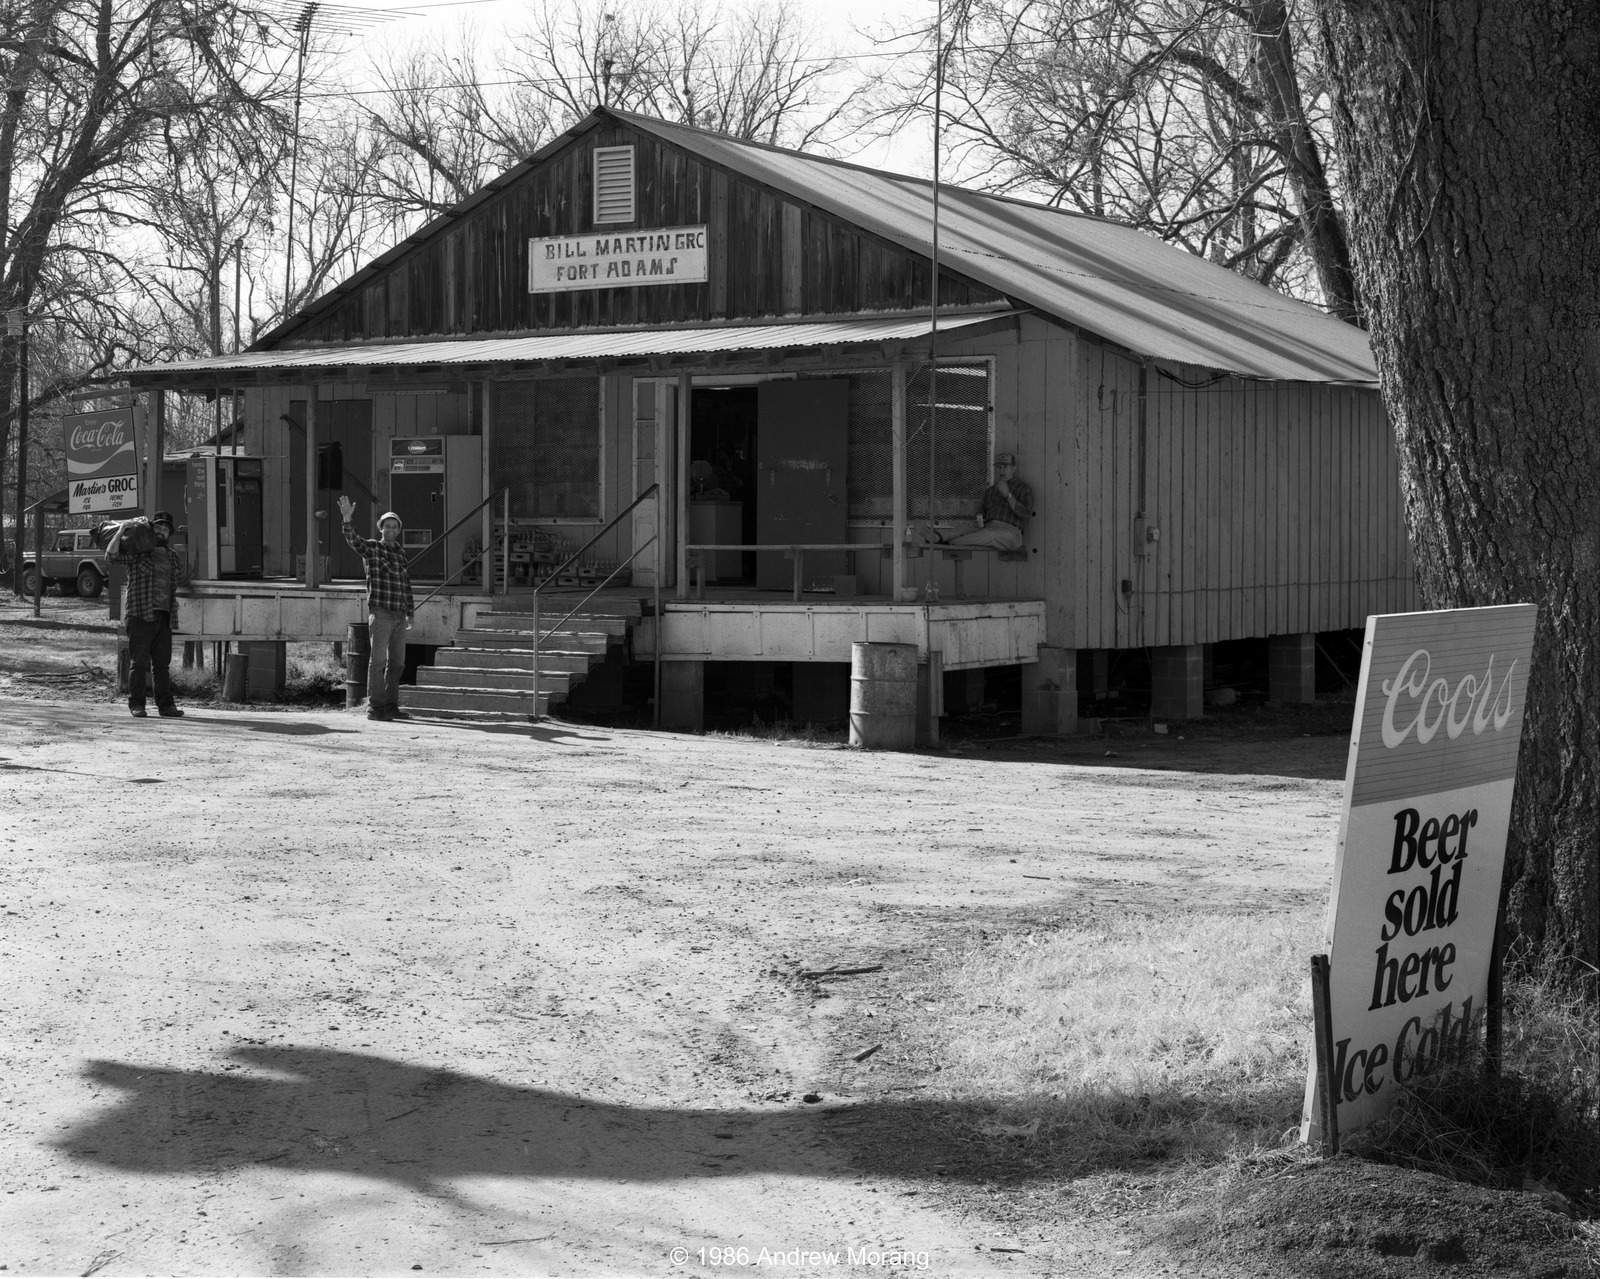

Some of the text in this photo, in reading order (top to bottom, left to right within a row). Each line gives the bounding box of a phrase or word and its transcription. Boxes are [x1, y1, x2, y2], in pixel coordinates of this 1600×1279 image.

[545, 241, 587, 260] BILL
[595, 234, 671, 256] MARTIN
[557, 257, 678, 281] FORT ADAMS
[73, 482, 107, 498] Martin's
[1381, 648, 1518, 749] Coors
[1387, 808, 1479, 875] Beer
[1381, 859, 1464, 942] sold
[1368, 942, 1457, 1012] here
[1334, 995, 1473, 1105] Ice Cold
